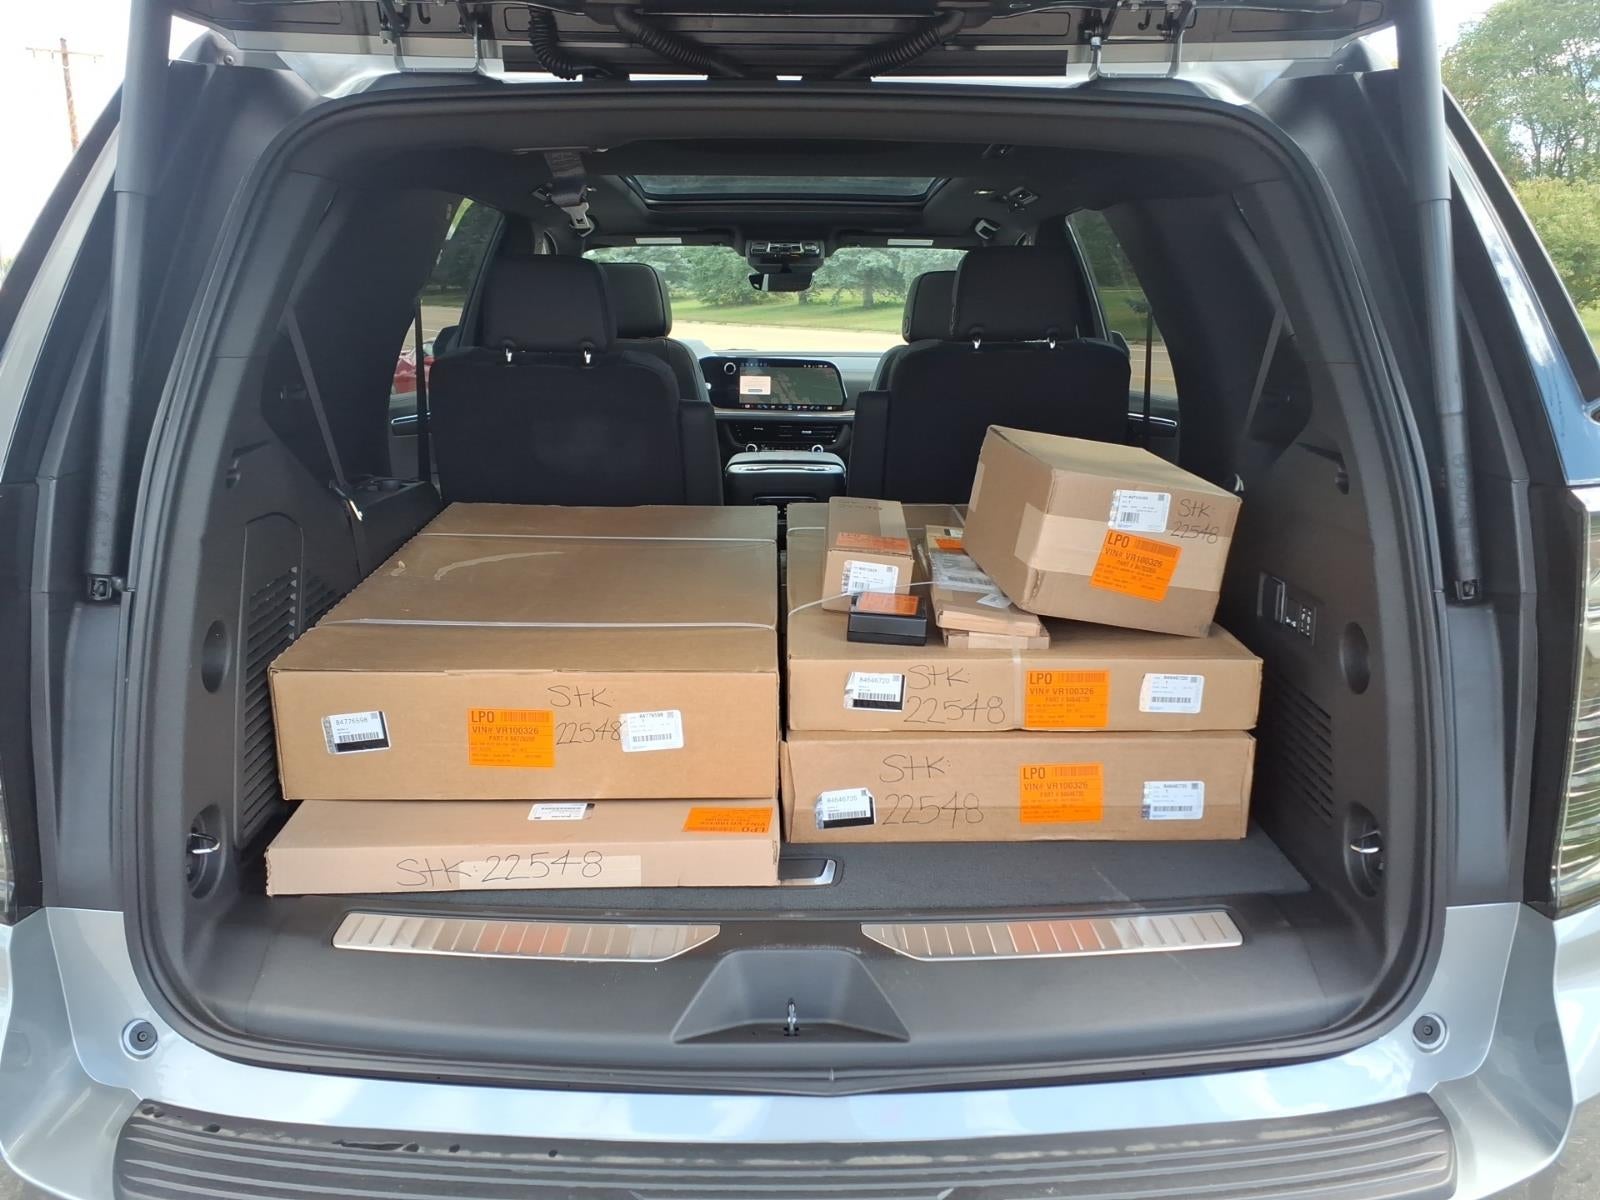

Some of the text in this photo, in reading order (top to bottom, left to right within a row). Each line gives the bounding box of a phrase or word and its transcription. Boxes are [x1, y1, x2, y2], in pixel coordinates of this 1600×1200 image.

[1107, 532, 1130, 549] LPO
[1170, 521, 1221, 545] 22548
[1029, 672, 1053, 685] LPO
[1052, 687, 1095, 697] VR100326
[471, 710, 495, 723] LPO
[904, 692, 1005, 725] 22548
[496, 726, 539, 736] VR100326
[556, 718, 622, 745] 22548
[1023, 766, 1046, 780] LPO
[882, 791, 984, 829] 22548
[482, 849, 603, 882] 22548
